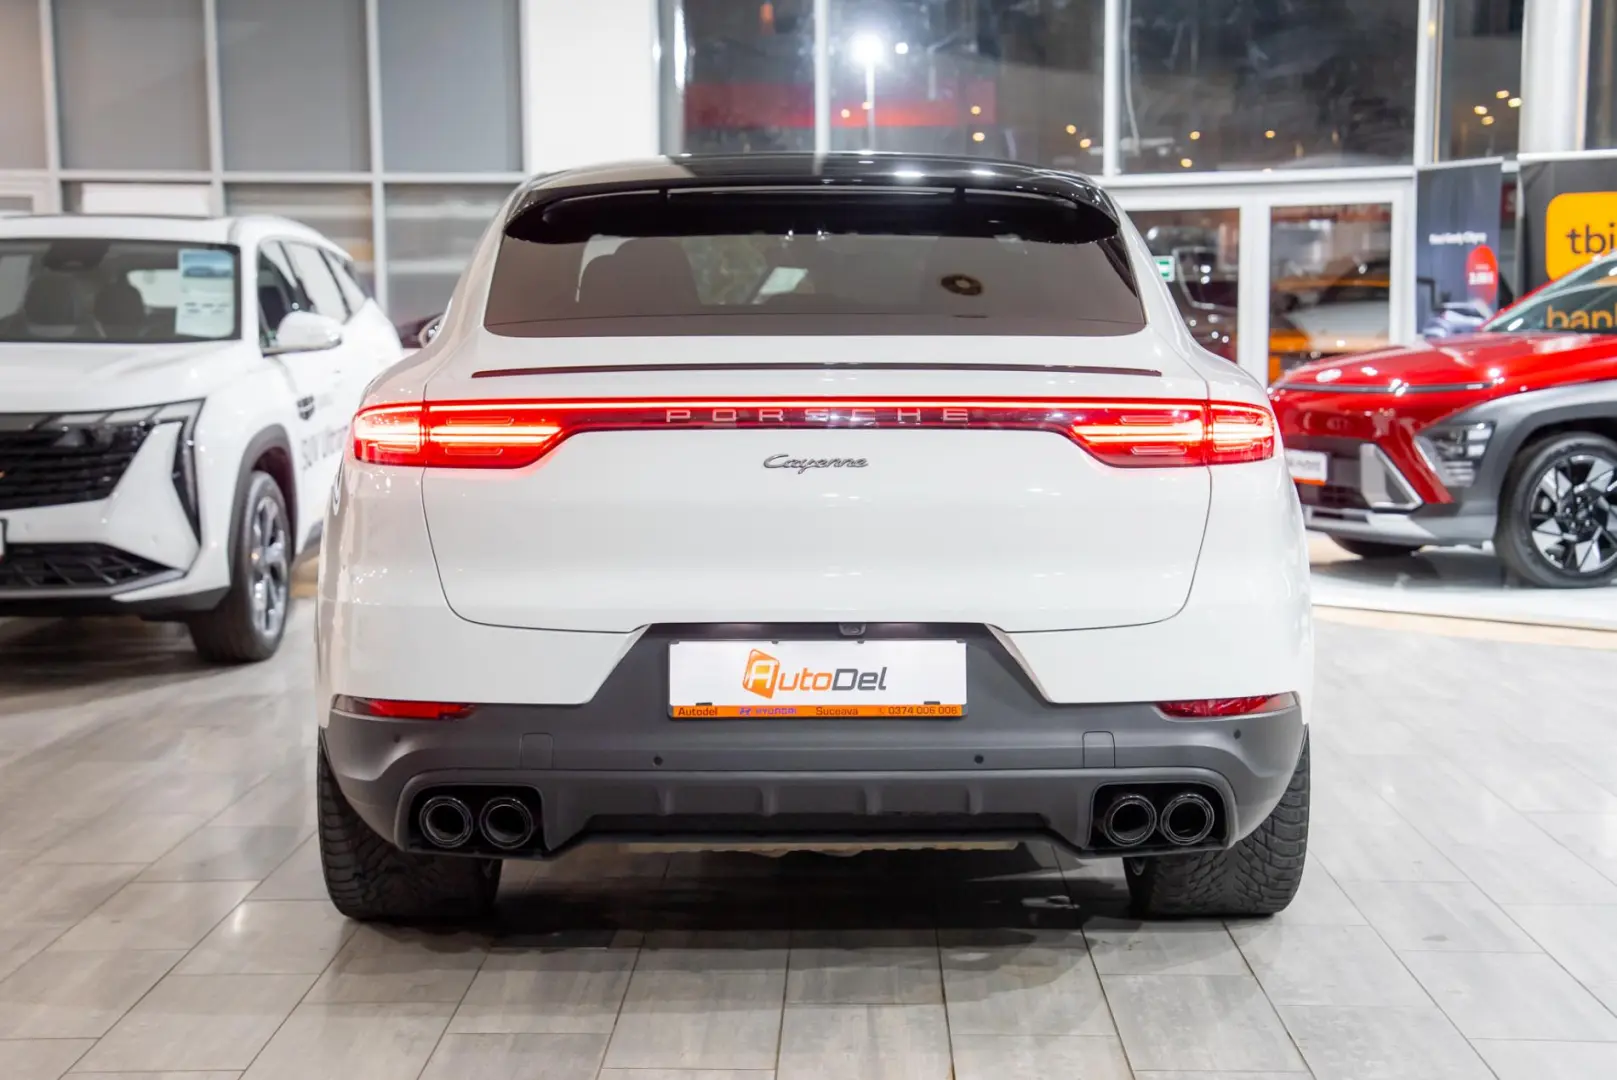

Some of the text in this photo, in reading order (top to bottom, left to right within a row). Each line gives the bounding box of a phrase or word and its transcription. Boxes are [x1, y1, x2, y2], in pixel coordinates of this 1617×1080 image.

[1566, 222, 1615, 254] tbi
[1546, 303, 1617, 329] ban
[665, 408, 969, 423] PORSCHE
[763, 453, 869, 474] Cayenne
[744, 652, 888, 695] AutoDel
[677, 707, 718, 716] Autodel
[815, 706, 859, 716] Suceava
[887, 705, 913, 715] 0374
